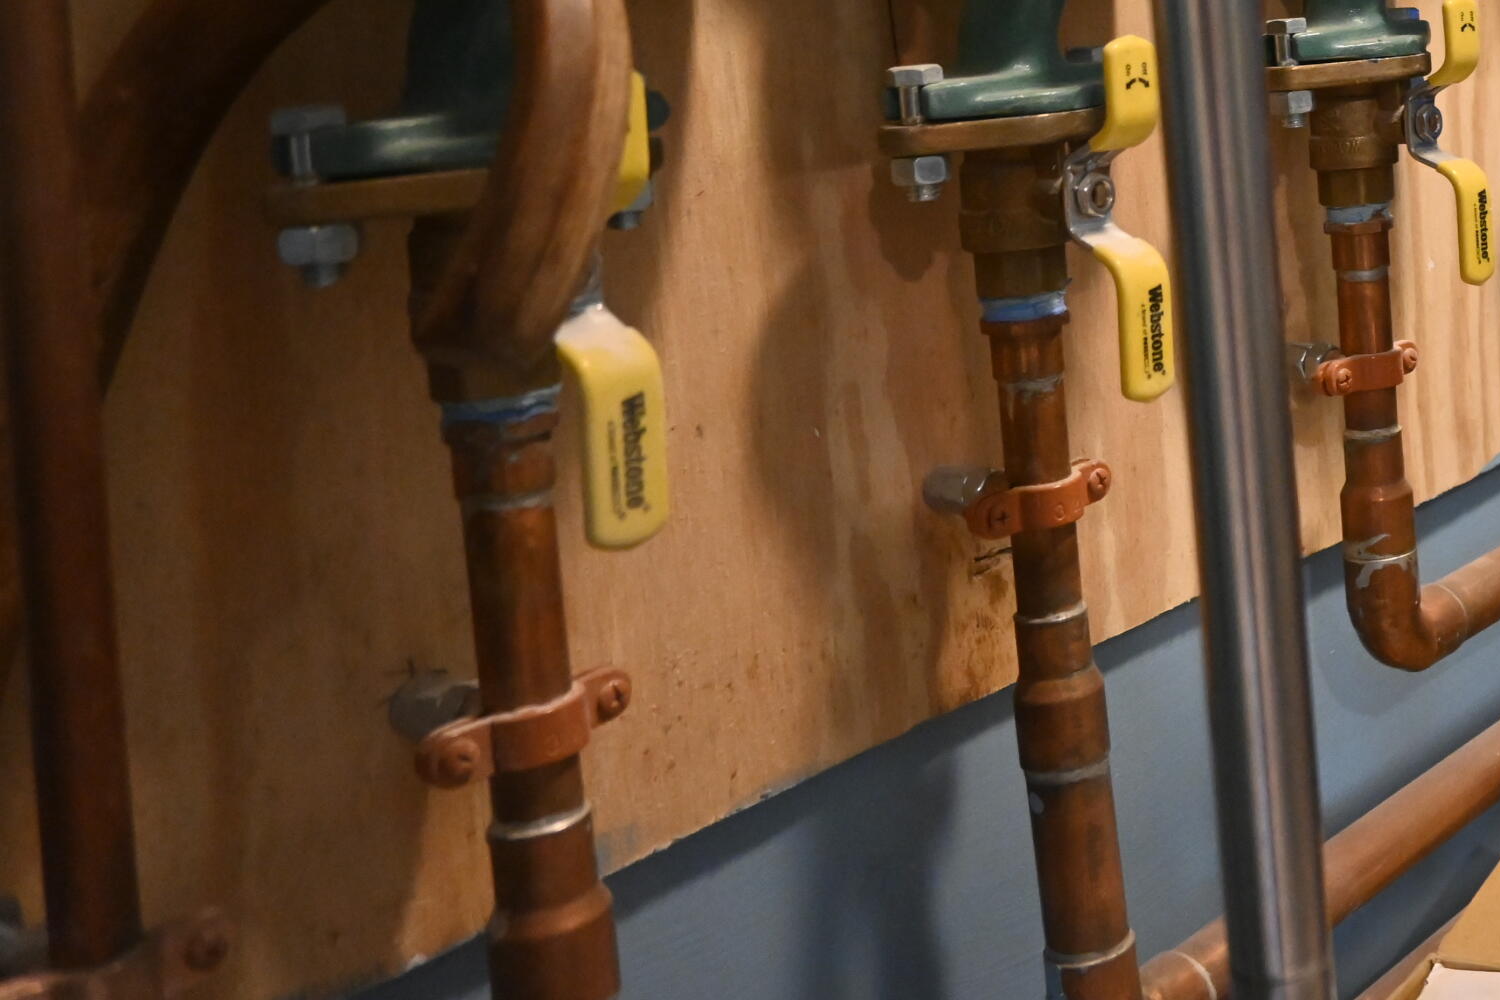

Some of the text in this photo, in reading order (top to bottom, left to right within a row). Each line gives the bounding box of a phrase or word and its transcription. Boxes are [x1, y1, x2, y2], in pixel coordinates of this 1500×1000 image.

[1477, 188, 1489, 259] Webstone
[1147, 283, 1165, 373] Webstone
[620, 390, 647, 510] Webstone
